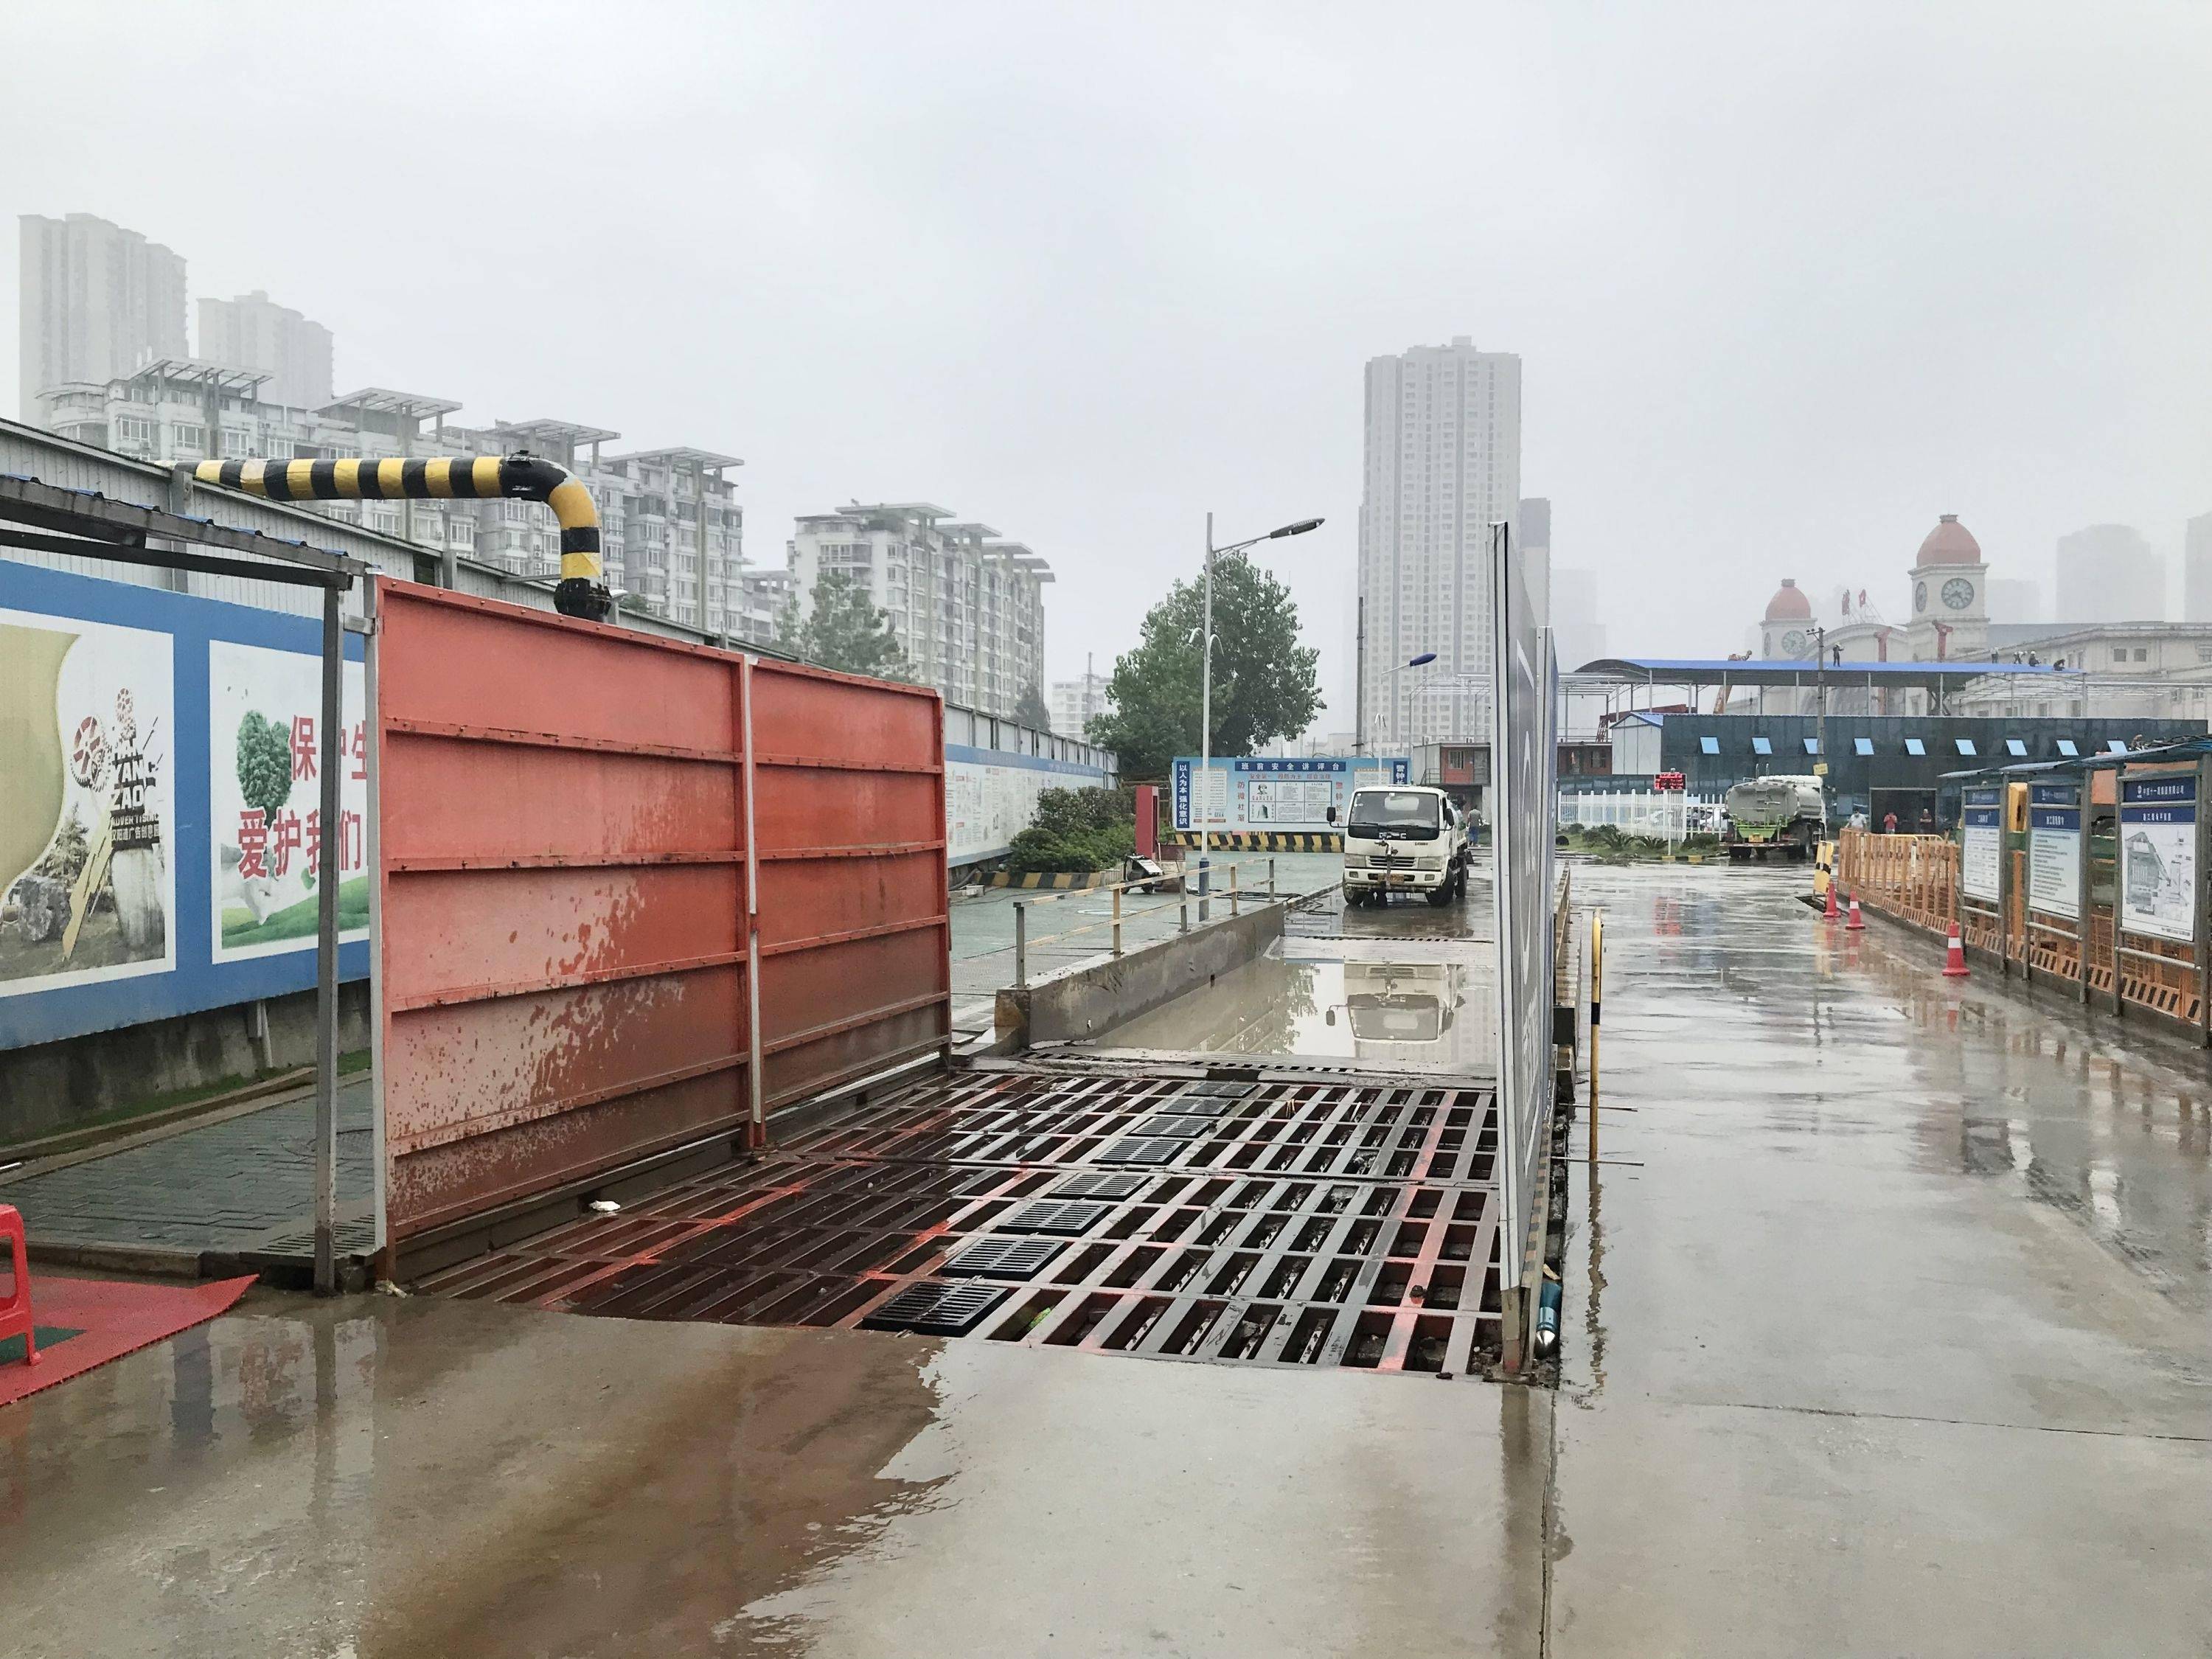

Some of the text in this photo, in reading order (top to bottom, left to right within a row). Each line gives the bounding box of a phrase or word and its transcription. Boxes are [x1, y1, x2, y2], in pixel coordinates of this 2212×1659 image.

[1241, 762, 1339, 771] 班前安全讲评台
